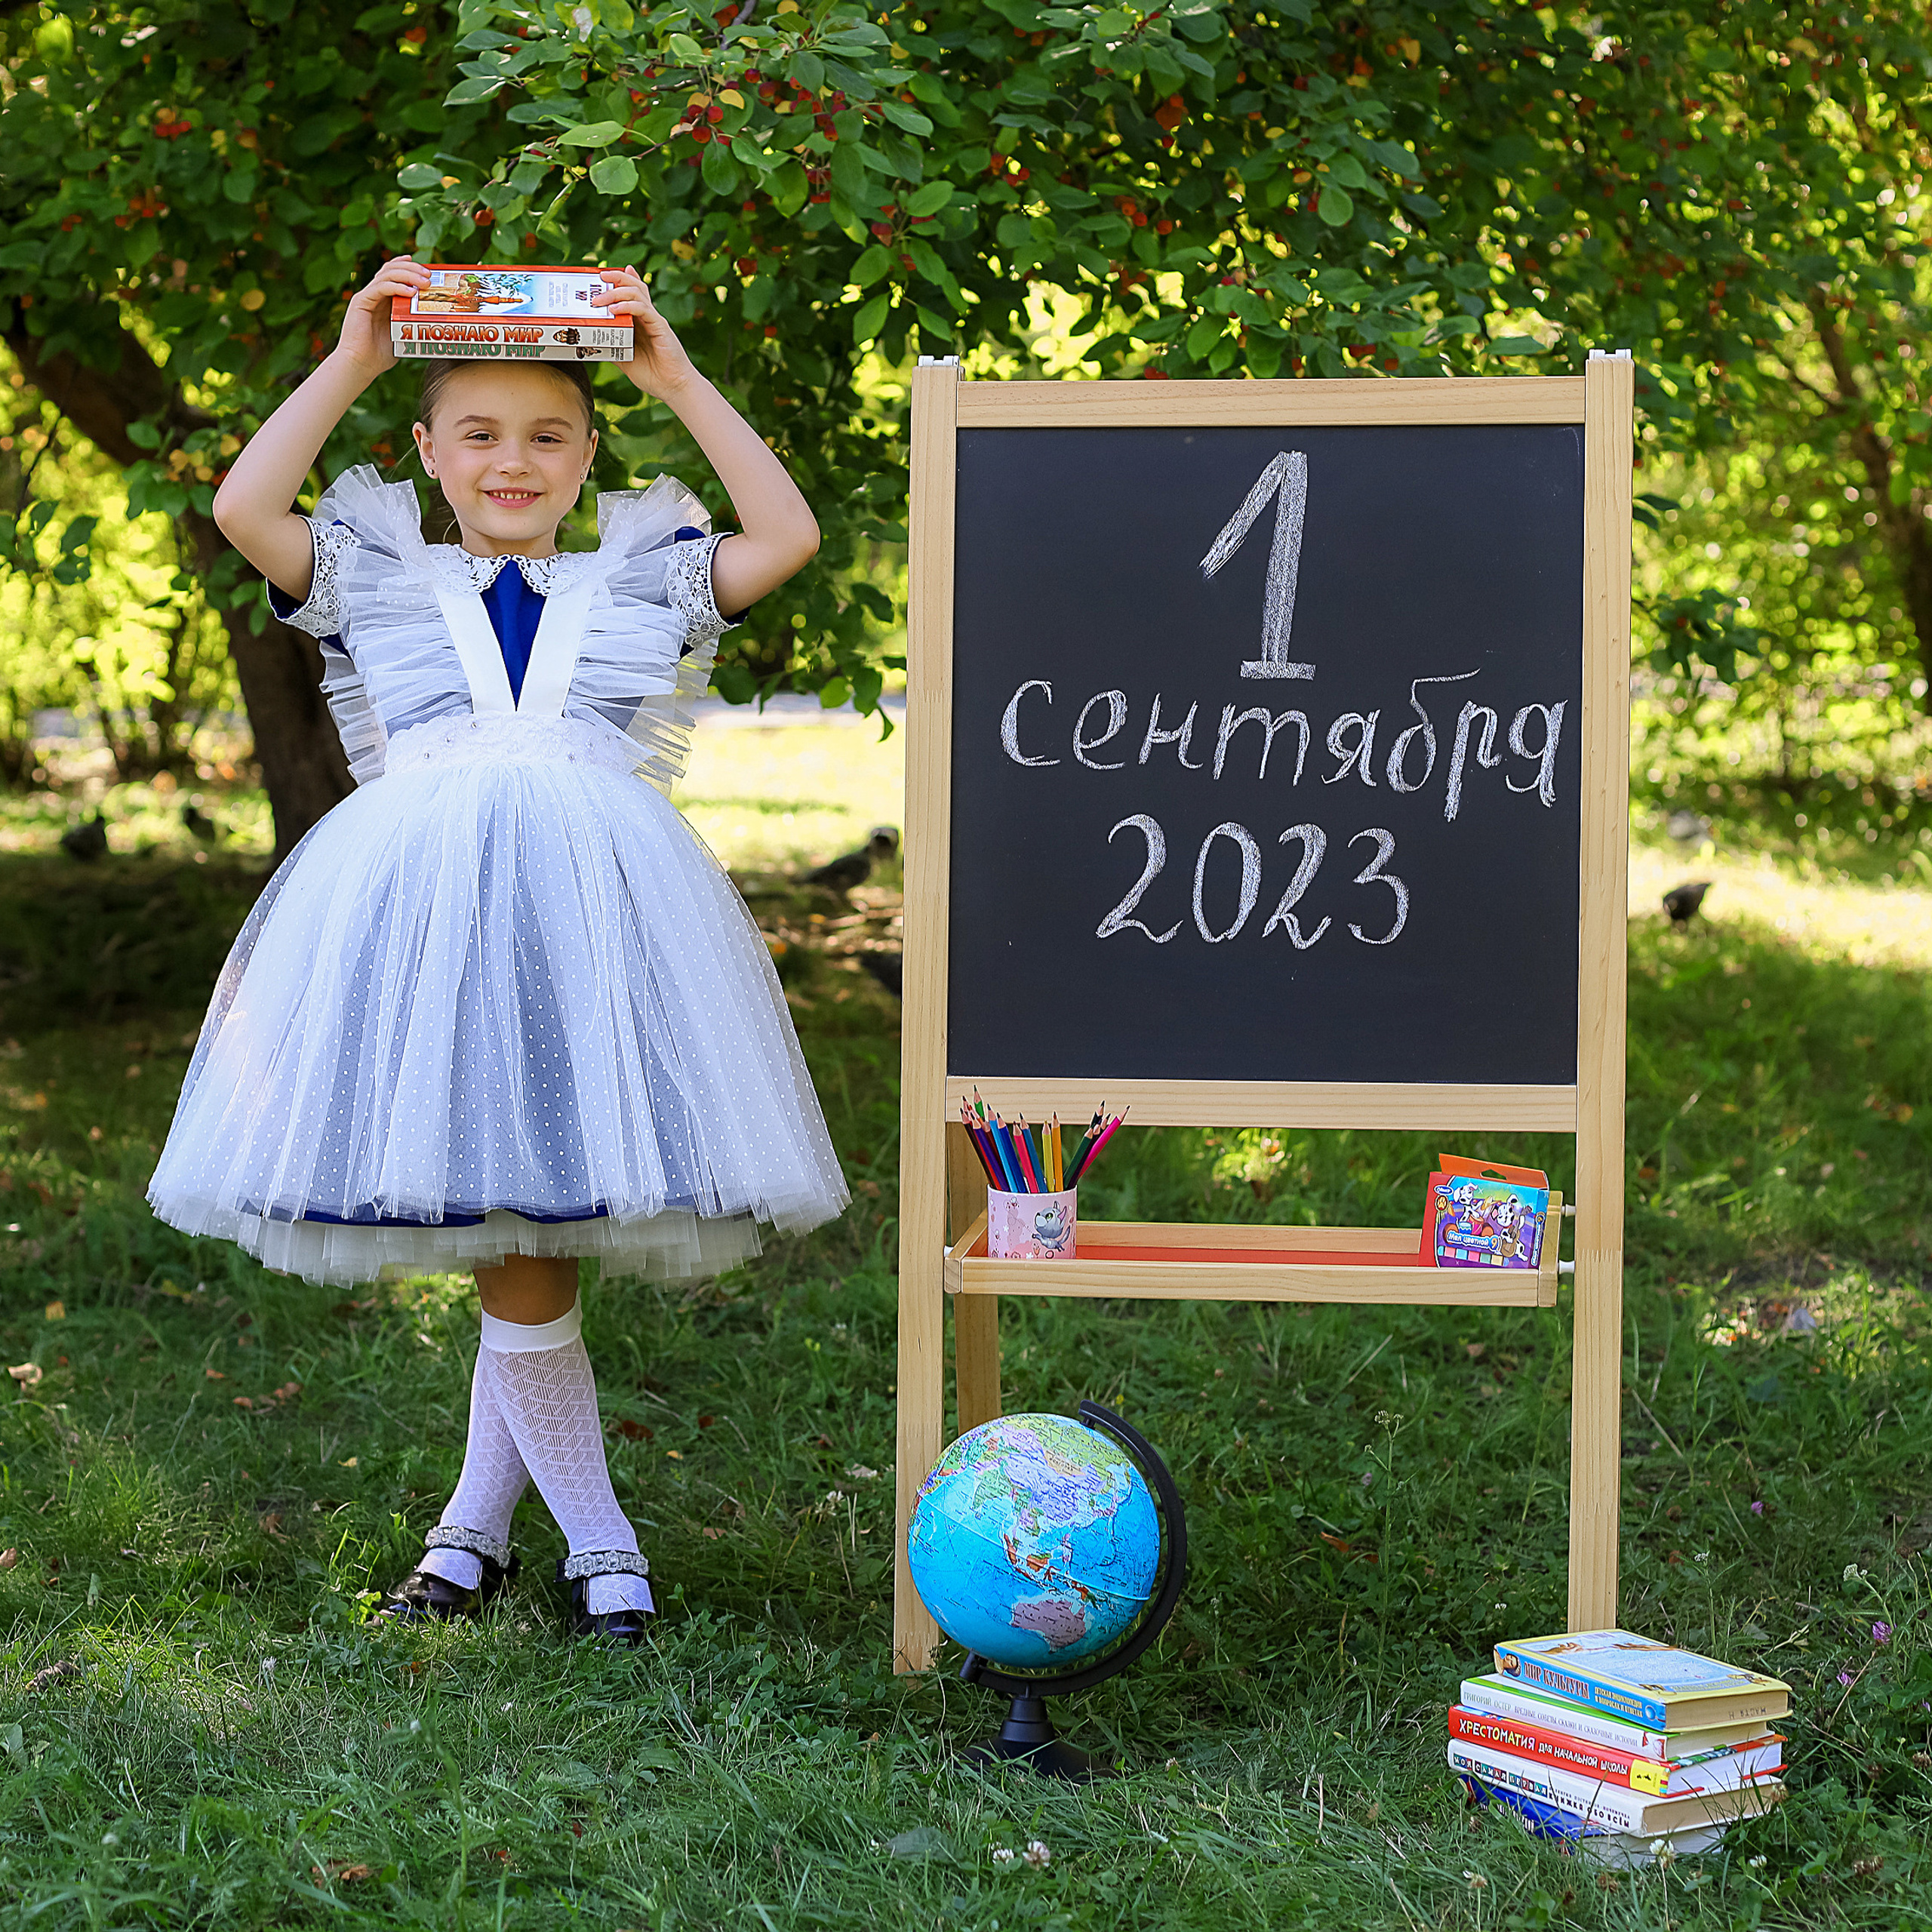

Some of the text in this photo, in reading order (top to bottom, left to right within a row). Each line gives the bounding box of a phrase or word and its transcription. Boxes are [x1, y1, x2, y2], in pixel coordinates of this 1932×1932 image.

[400, 325, 543, 343] Я ПОЗНАЮ МИР
[420, 343, 501, 357] ПОЗНАЮ
[505, 345, 546, 358] МИР
[1197, 451, 1315, 680] 1
[1096, 814, 1408, 949] 2023
[1491, 1238, 1497, 1248] 9
[1524, 1662, 1589, 1699] МИР КУЛЬТУРЫ
[1464, 1691, 1492, 1706] ГРИГОРИЙ
[1494, 1700, 1512, 1712] ОСТЕР
[1514, 1706, 1536, 1718] ВРЕДНЫЕ
[1615, 1734, 1638, 1746] ИСТОРИИ
[1459, 1718, 1535, 1751] ХРЕСТОМАТИЯ
[1554, 1746, 1598, 1768] НАЧАЛЬНОЙ
[1601, 1760, 1629, 1775] ШКОЛЫ
[1454, 1755, 1472, 1769] МОЯ
[1476, 1762, 1506, 1780] САМАЯ
[1509, 1774, 1547, 1796] ПЕРВАЯ
[1549, 1792, 1583, 1810] КНИЖКА
